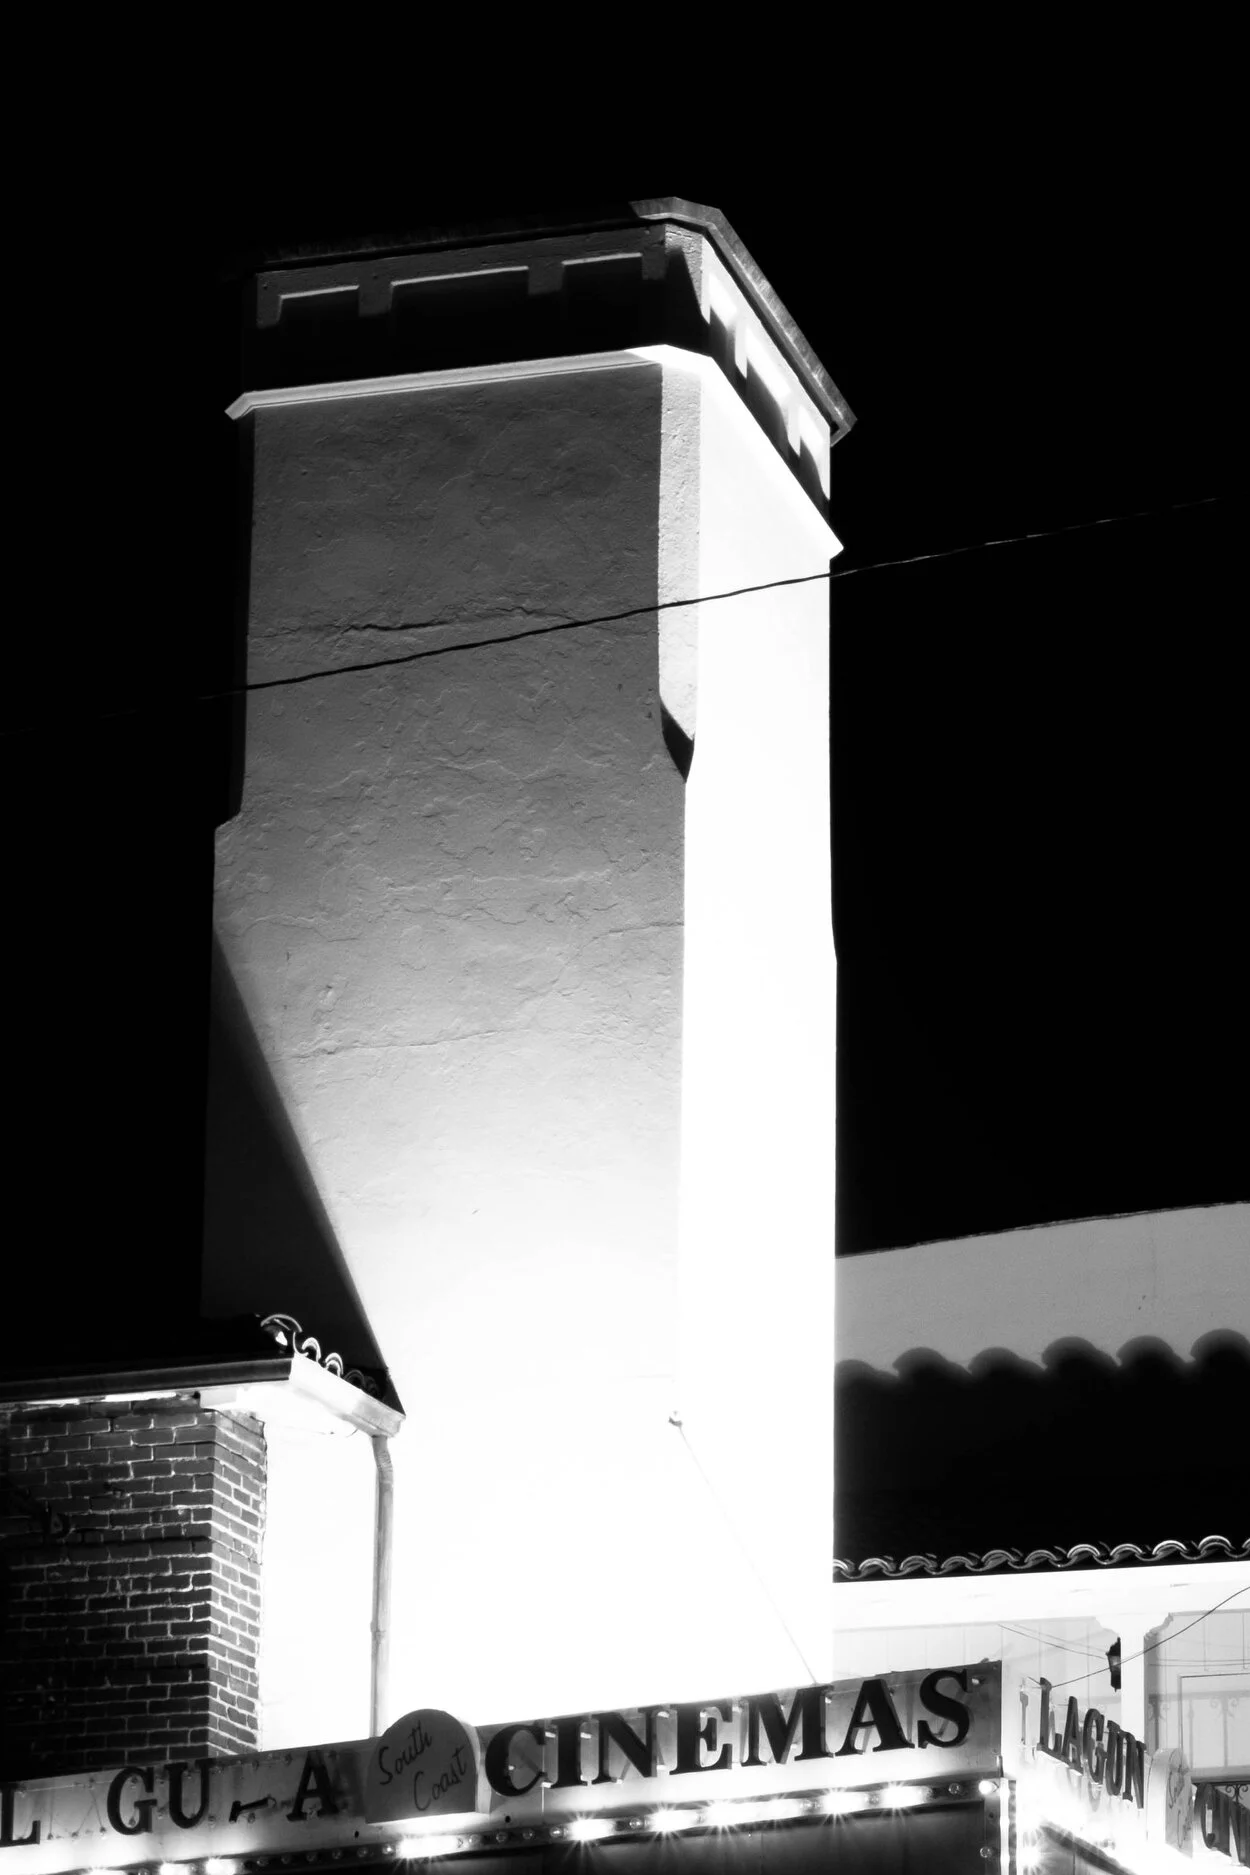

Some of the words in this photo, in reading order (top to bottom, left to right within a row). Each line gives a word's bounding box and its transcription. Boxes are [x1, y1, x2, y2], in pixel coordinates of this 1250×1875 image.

[378, 1719, 432, 1785] South
[484, 1668, 972, 1797] CINEMAS
[413, 1745, 467, 1811] Coast
